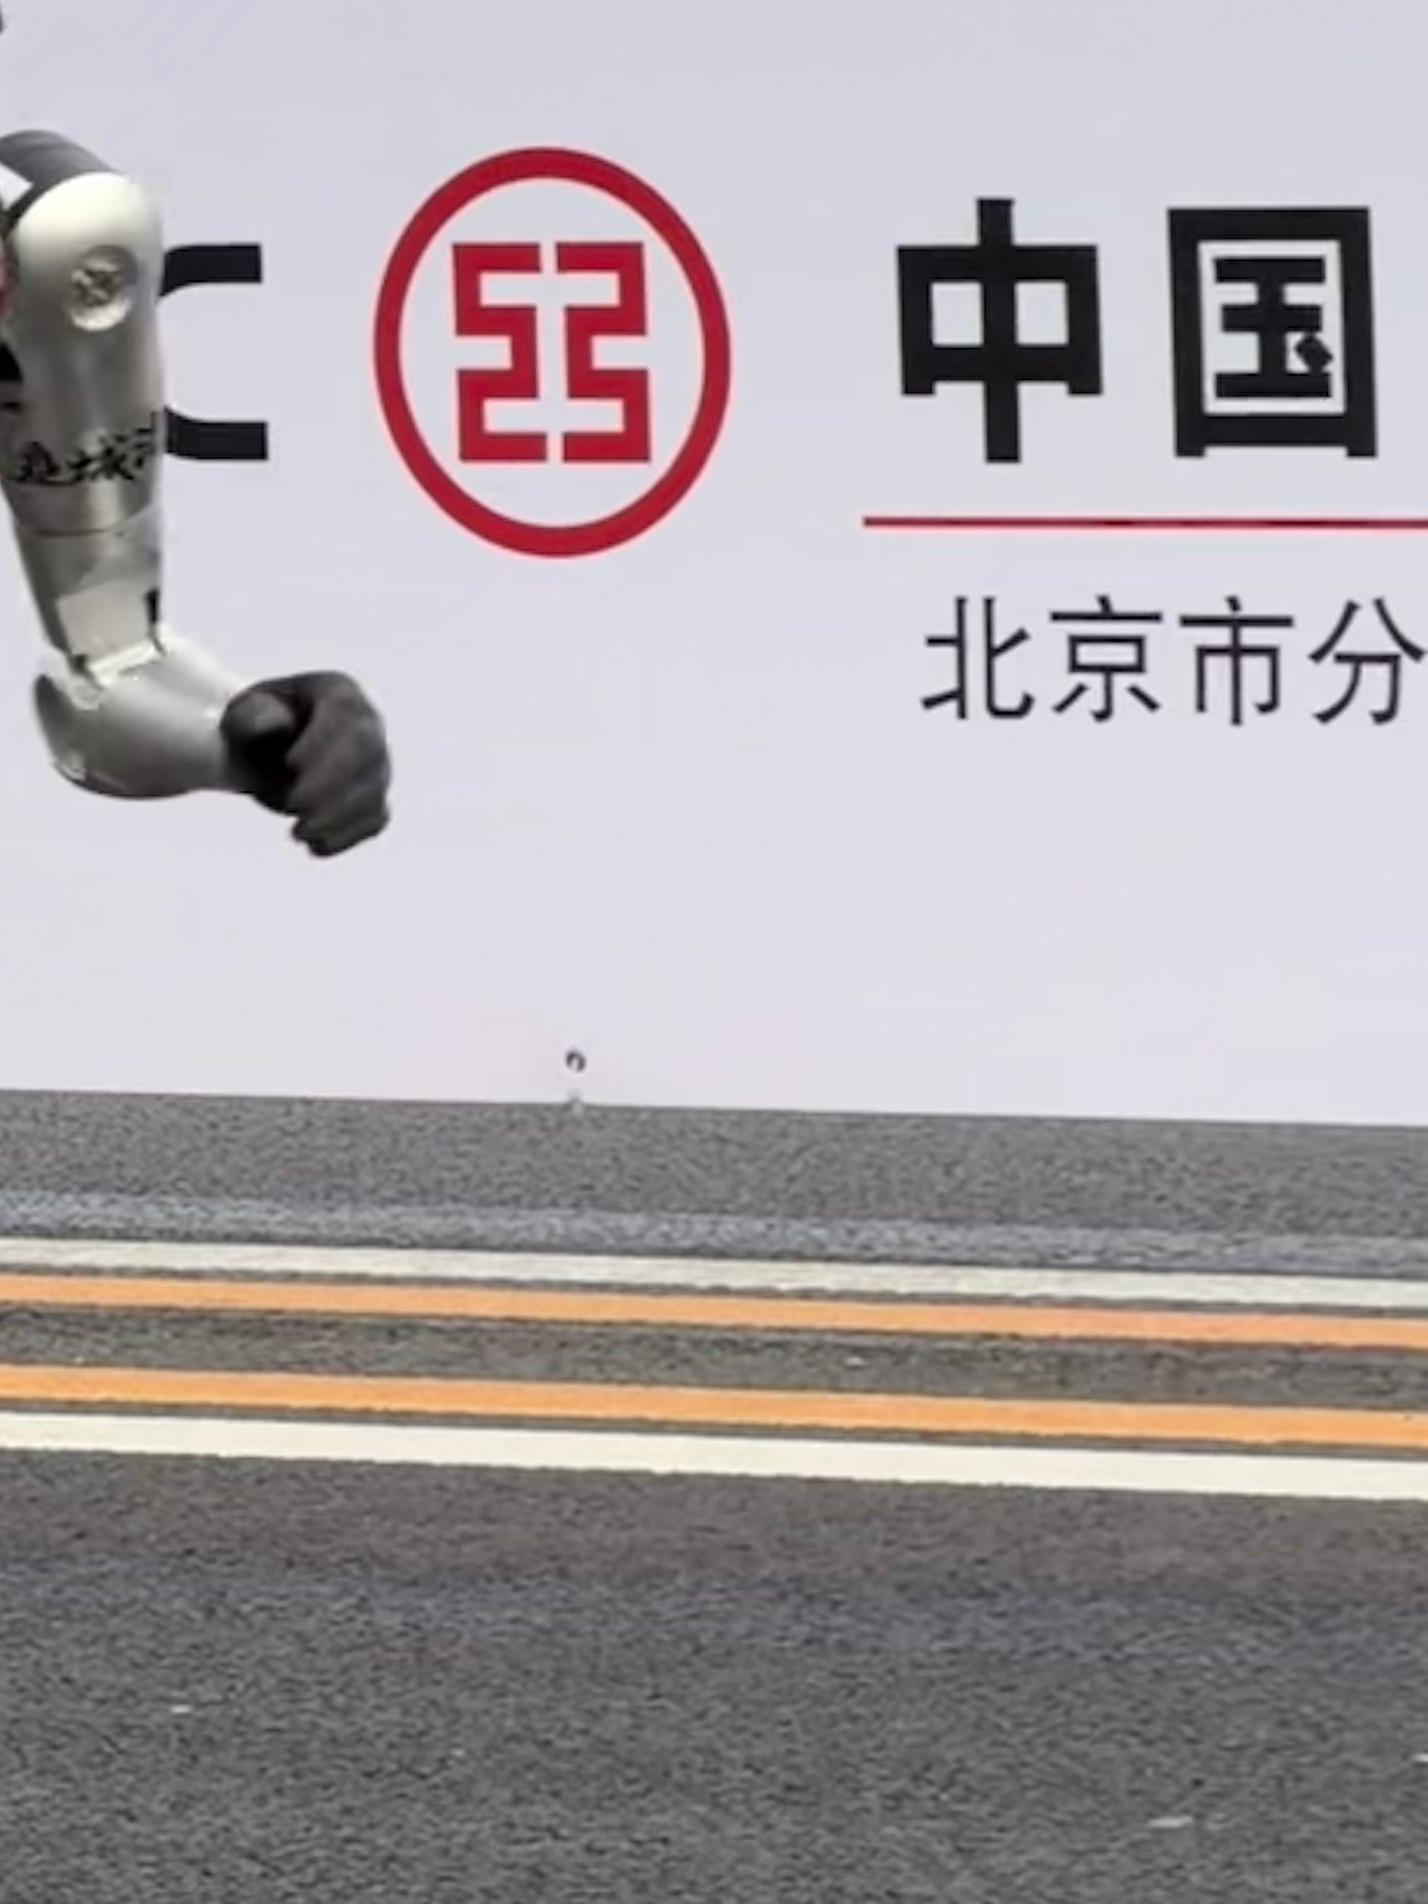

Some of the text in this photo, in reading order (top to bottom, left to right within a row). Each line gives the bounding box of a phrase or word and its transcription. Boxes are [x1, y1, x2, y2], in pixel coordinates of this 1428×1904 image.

[896, 198, 1377, 463] 中国
[921, 595, 1427, 725] 北京市分
